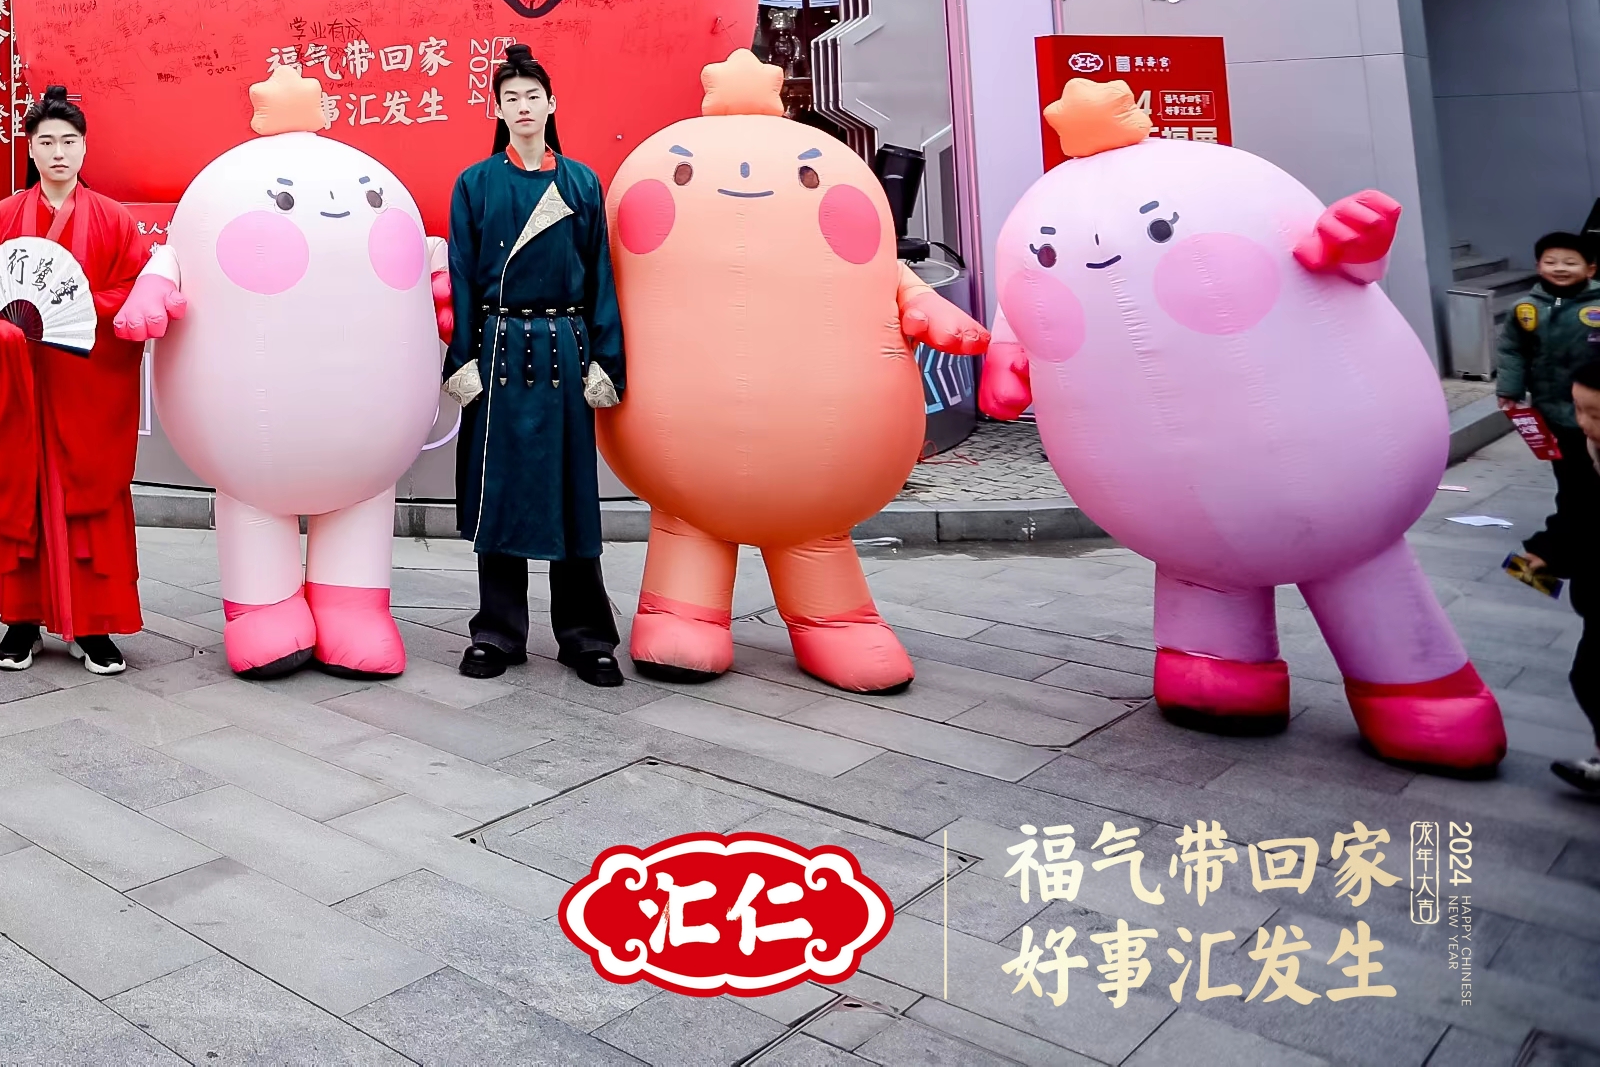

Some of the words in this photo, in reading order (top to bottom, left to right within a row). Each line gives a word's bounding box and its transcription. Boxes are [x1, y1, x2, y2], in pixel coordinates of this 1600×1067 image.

[265, 36, 454, 80] 福气带回家
[468, 38, 490, 107] 2024
[319, 89, 449, 130] 事汇发生
